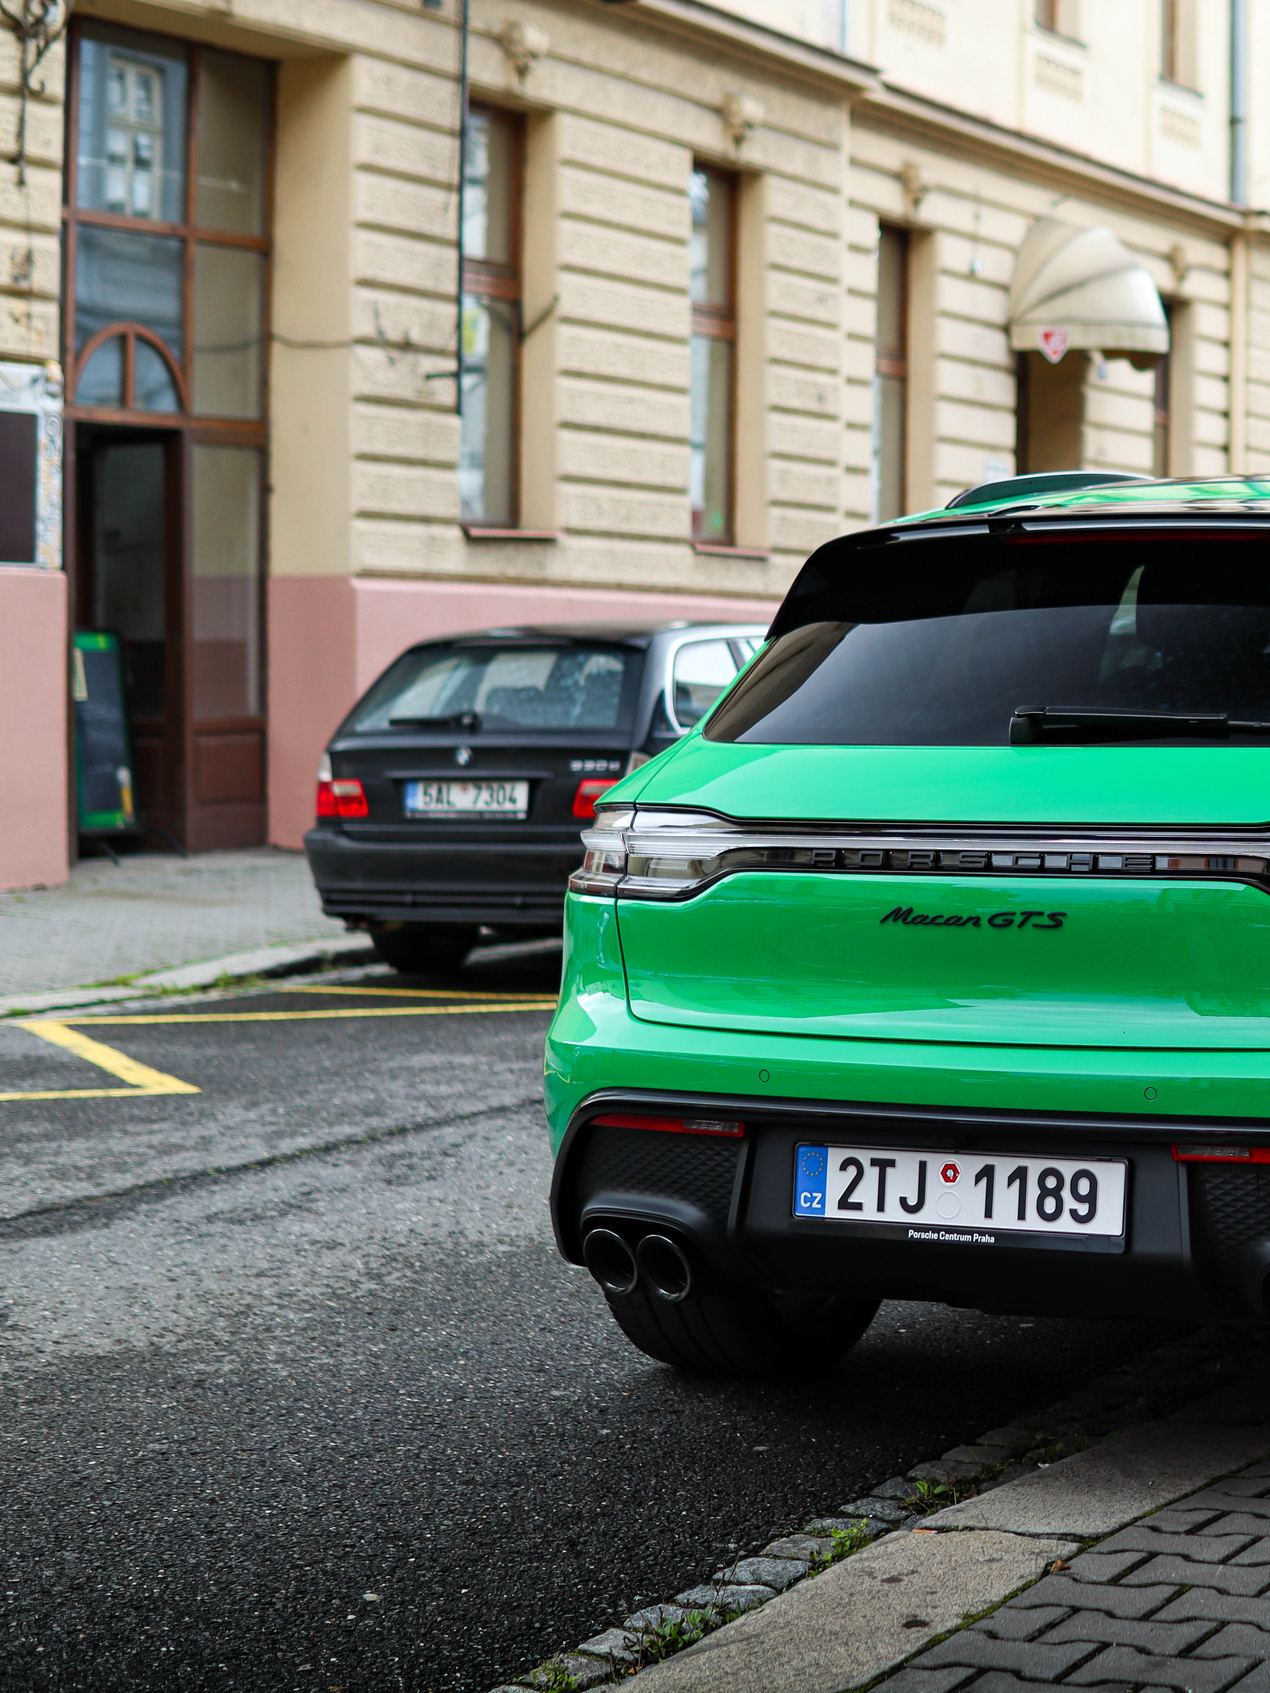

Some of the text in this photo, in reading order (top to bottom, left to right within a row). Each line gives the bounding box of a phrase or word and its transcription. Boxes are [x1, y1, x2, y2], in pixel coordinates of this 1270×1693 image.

[422, 784, 518, 807] 5AL 7304
[811, 850, 1153, 872] PORSCHE
[879, 906, 1067, 929] Macan GTS
[800, 1191, 822, 1209] CZ
[837, 1156, 1099, 1224] 2TJ 1189
[908, 1229, 995, 1243] Porsche Centrum Praha
